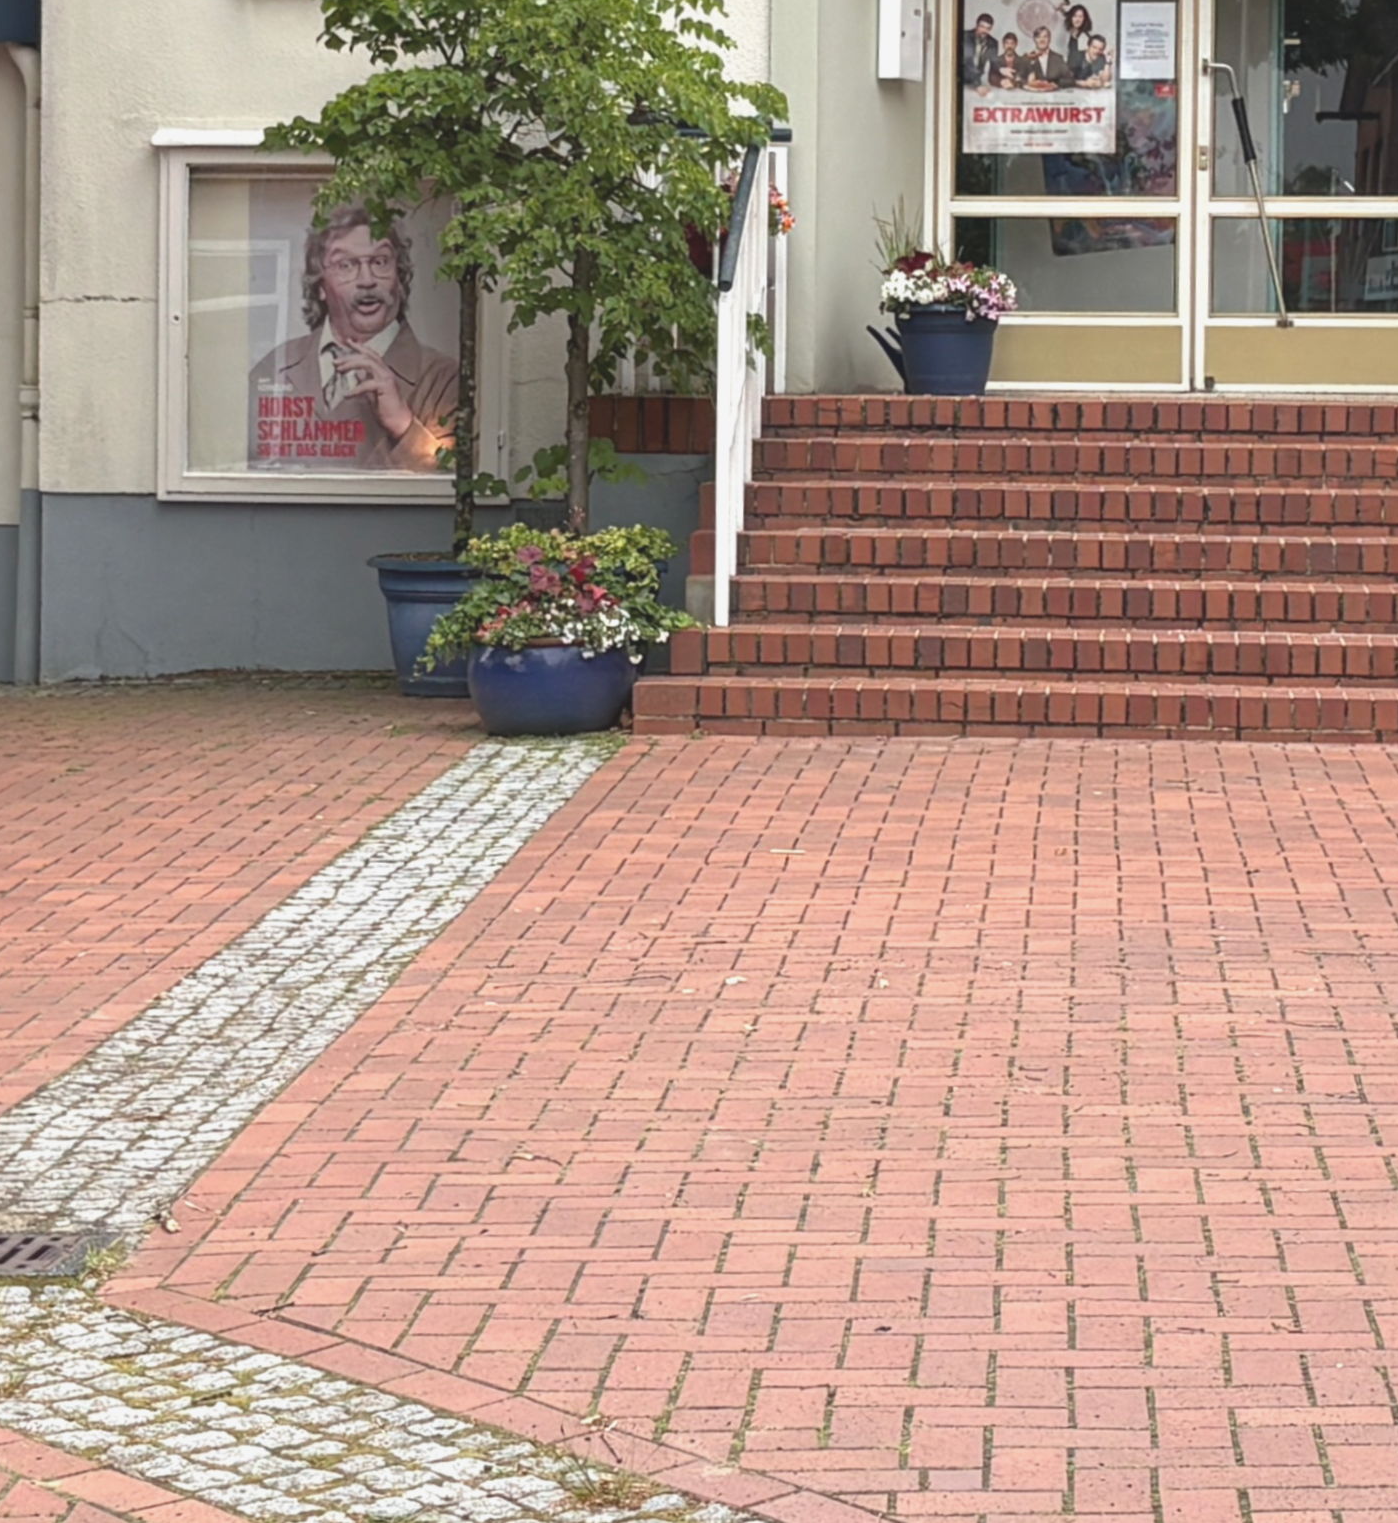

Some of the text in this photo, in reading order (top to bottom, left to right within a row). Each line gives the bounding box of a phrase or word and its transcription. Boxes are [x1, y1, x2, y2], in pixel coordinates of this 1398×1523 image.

[972, 106, 1106, 124] EXTRAWURST
[258, 396, 315, 418] HORST
[297, 443, 318, 457] DAS
